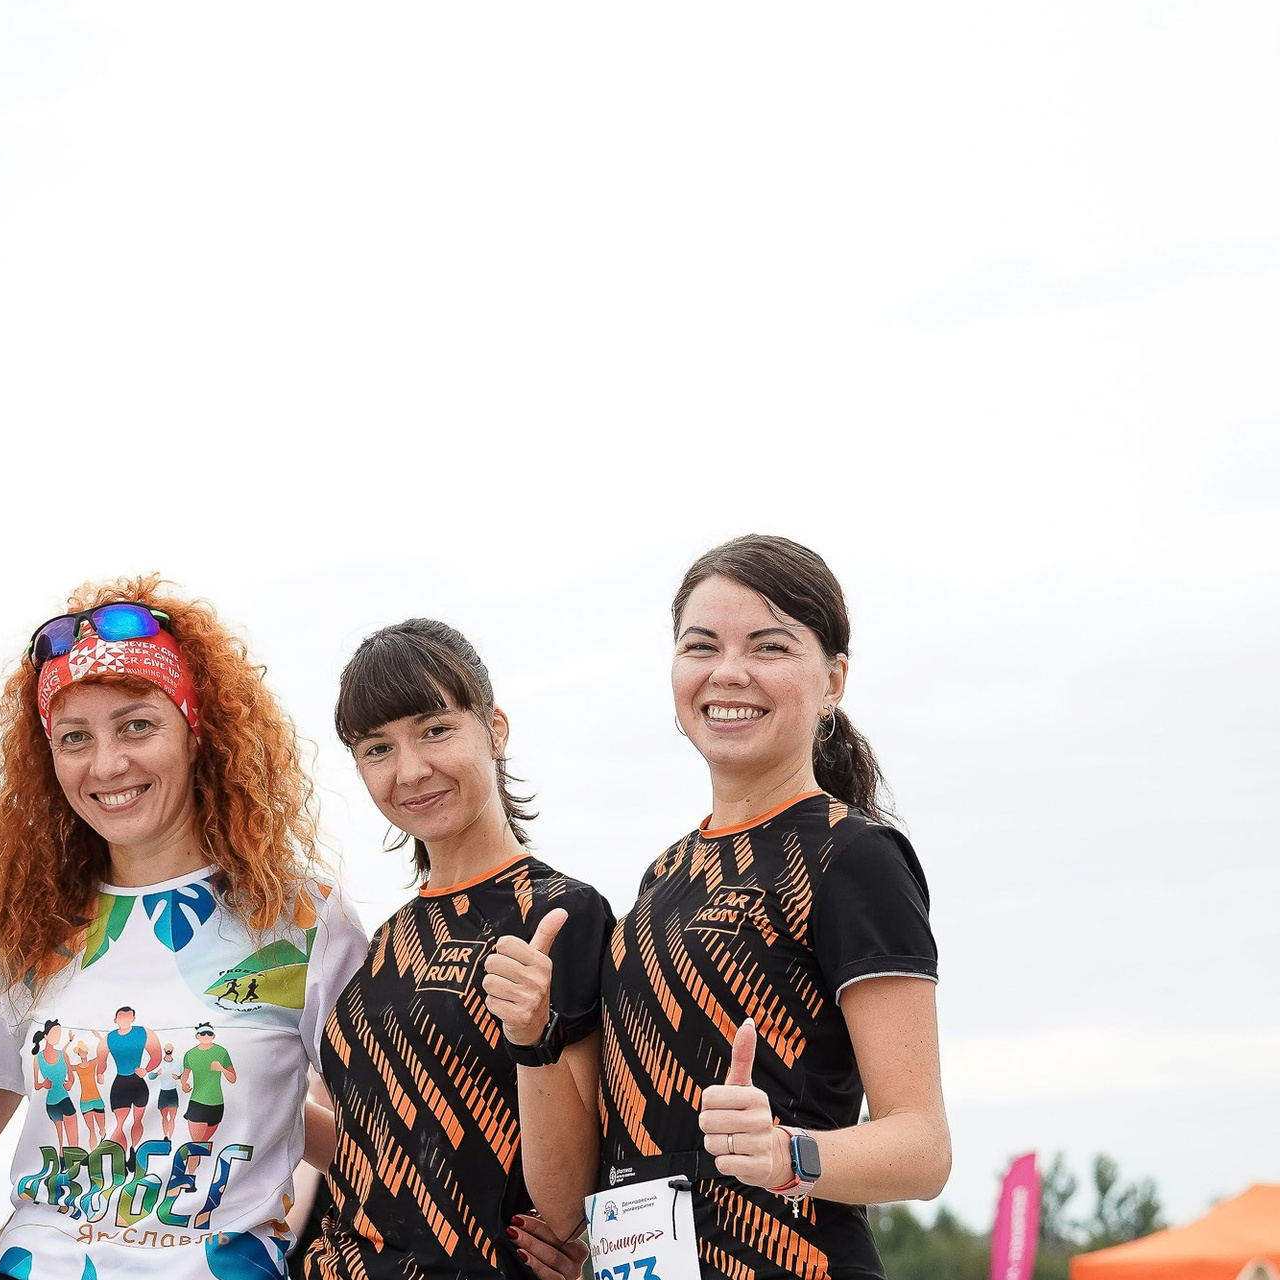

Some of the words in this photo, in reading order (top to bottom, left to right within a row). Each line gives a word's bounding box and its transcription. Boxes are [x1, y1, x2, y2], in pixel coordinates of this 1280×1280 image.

[695, 907, 740, 924] RUN
[438, 947, 473, 963] YAR
[424, 965, 467, 983] RUN
